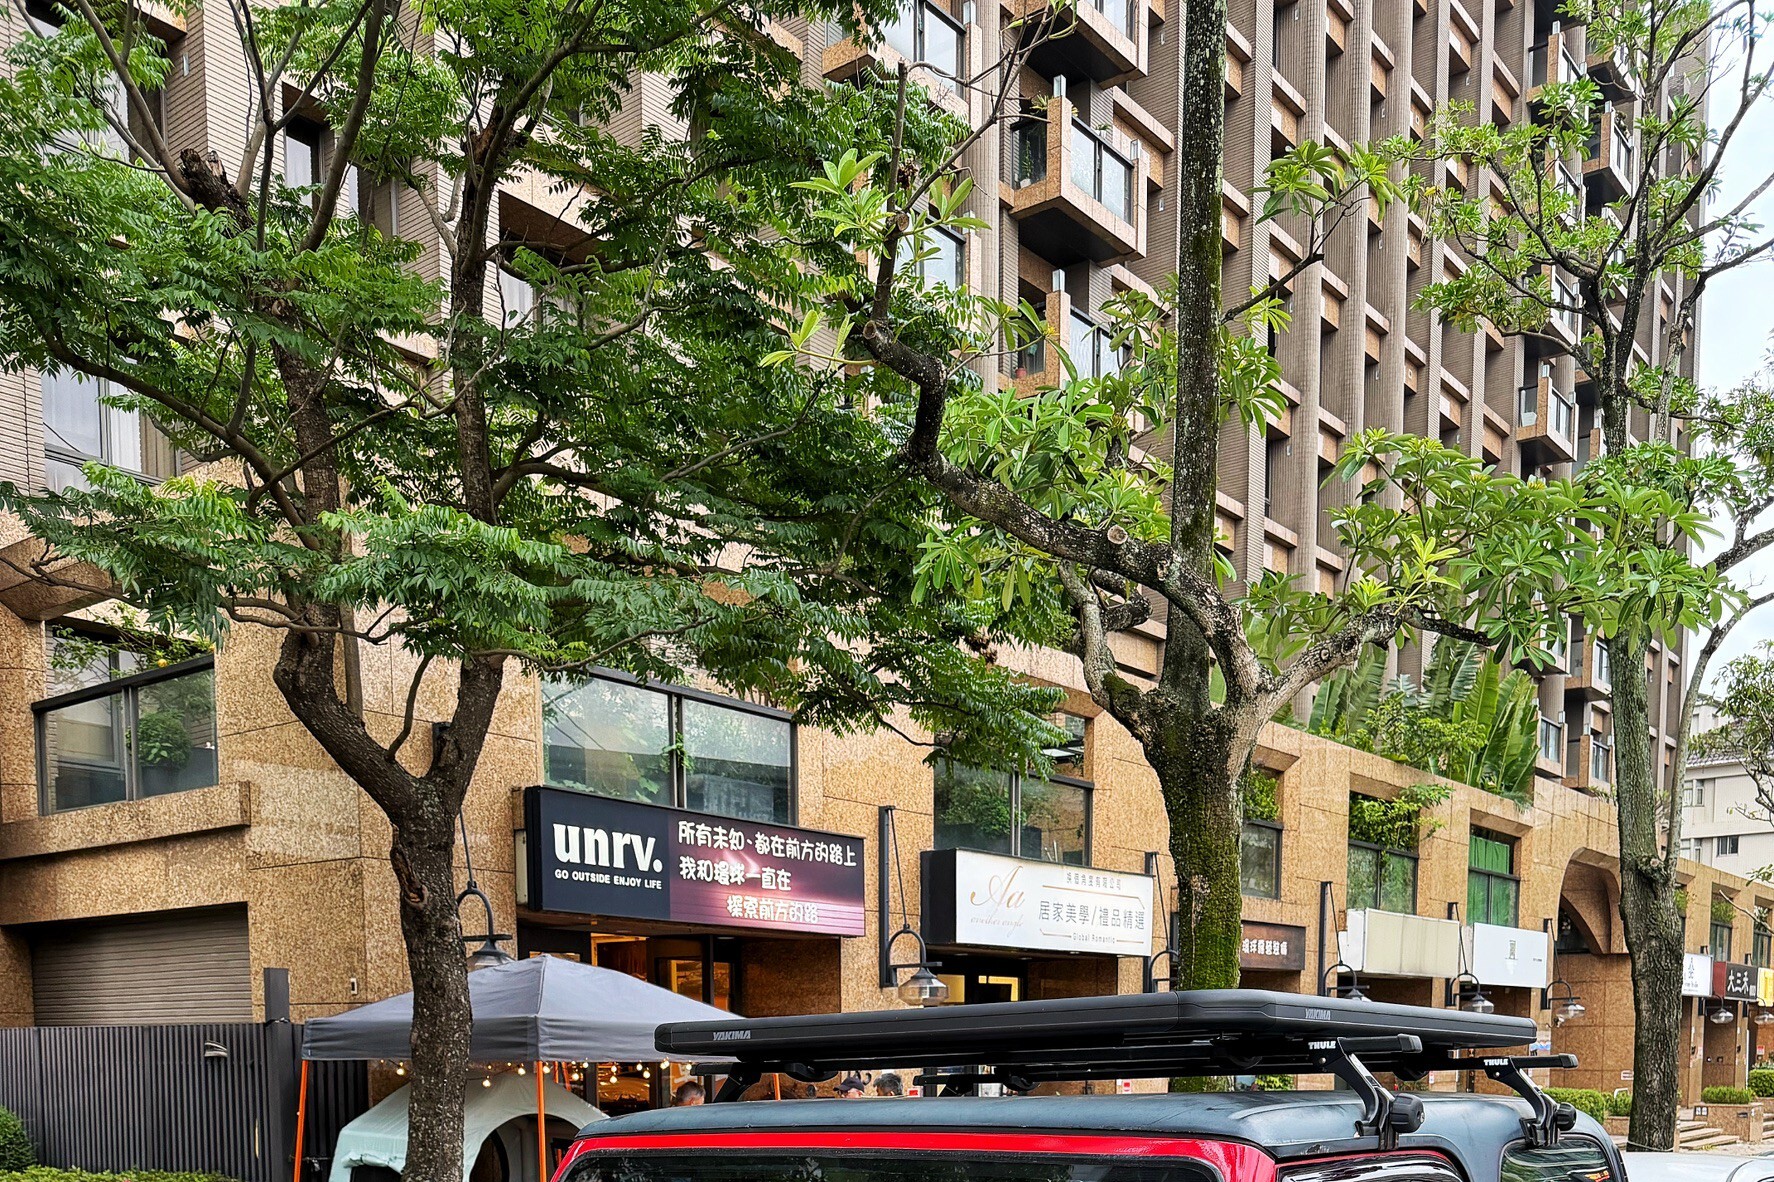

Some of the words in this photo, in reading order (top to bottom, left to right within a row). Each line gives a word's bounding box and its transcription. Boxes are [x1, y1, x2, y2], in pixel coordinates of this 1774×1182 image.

[553, 823, 663, 873] unrv.
[678, 820, 857, 867] 所有未知、都在前方的路上
[555, 868, 569, 880] GO
[572, 870, 611, 884] OUTSIDE
[613, 875, 642, 888] ENJOY
[644, 879, 663, 890] LIFE
[679, 855, 792, 891] 我和環球一直在
[726, 895, 819, 924] 探索前方的路
[1305, 1008, 1331, 1020] YAKIMA
[712, 1030, 750, 1041] YAKIMA
[1308, 1040, 1336, 1050] THULE
[1483, 1058, 1509, 1066] THULE
